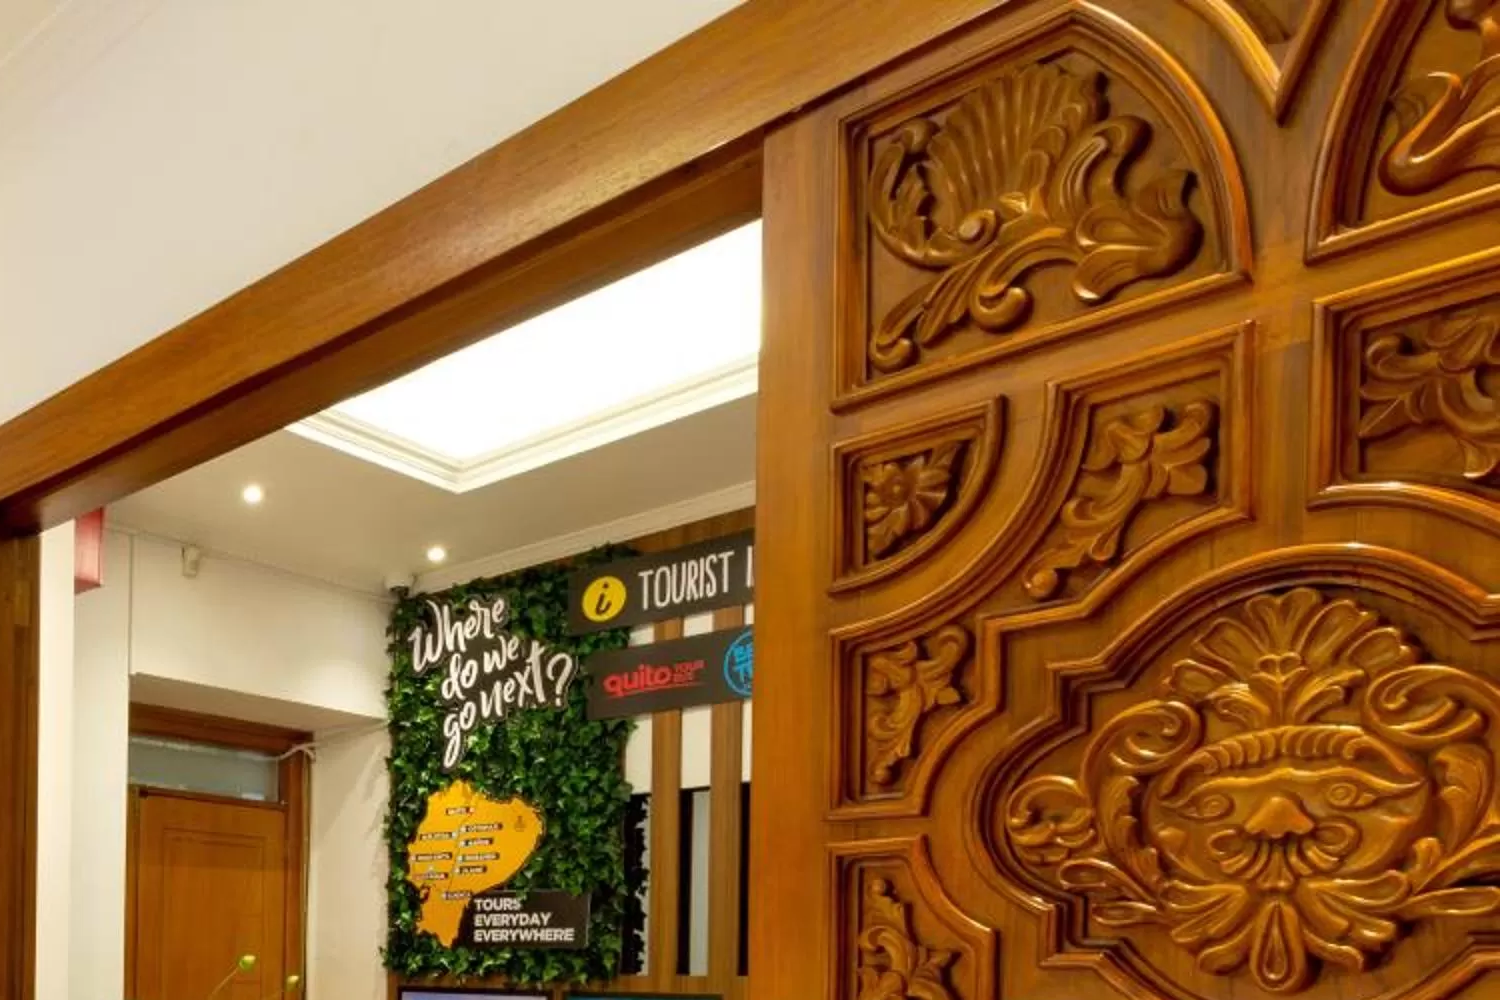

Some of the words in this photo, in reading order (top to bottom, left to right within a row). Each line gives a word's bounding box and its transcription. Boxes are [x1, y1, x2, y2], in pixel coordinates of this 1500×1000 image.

[638, 549, 735, 611] TOURIST
[408, 599, 505, 672] Where
[441, 653, 479, 700] do
[483, 635, 519, 673] we
[603, 662, 672, 697] quito
[443, 701, 477, 768] go
[480, 640, 574, 718] next?
[473, 912, 553, 927] EVERYDAY
[474, 897, 522, 911] TOURS
[473, 927, 575, 943] EVERYWHERE
